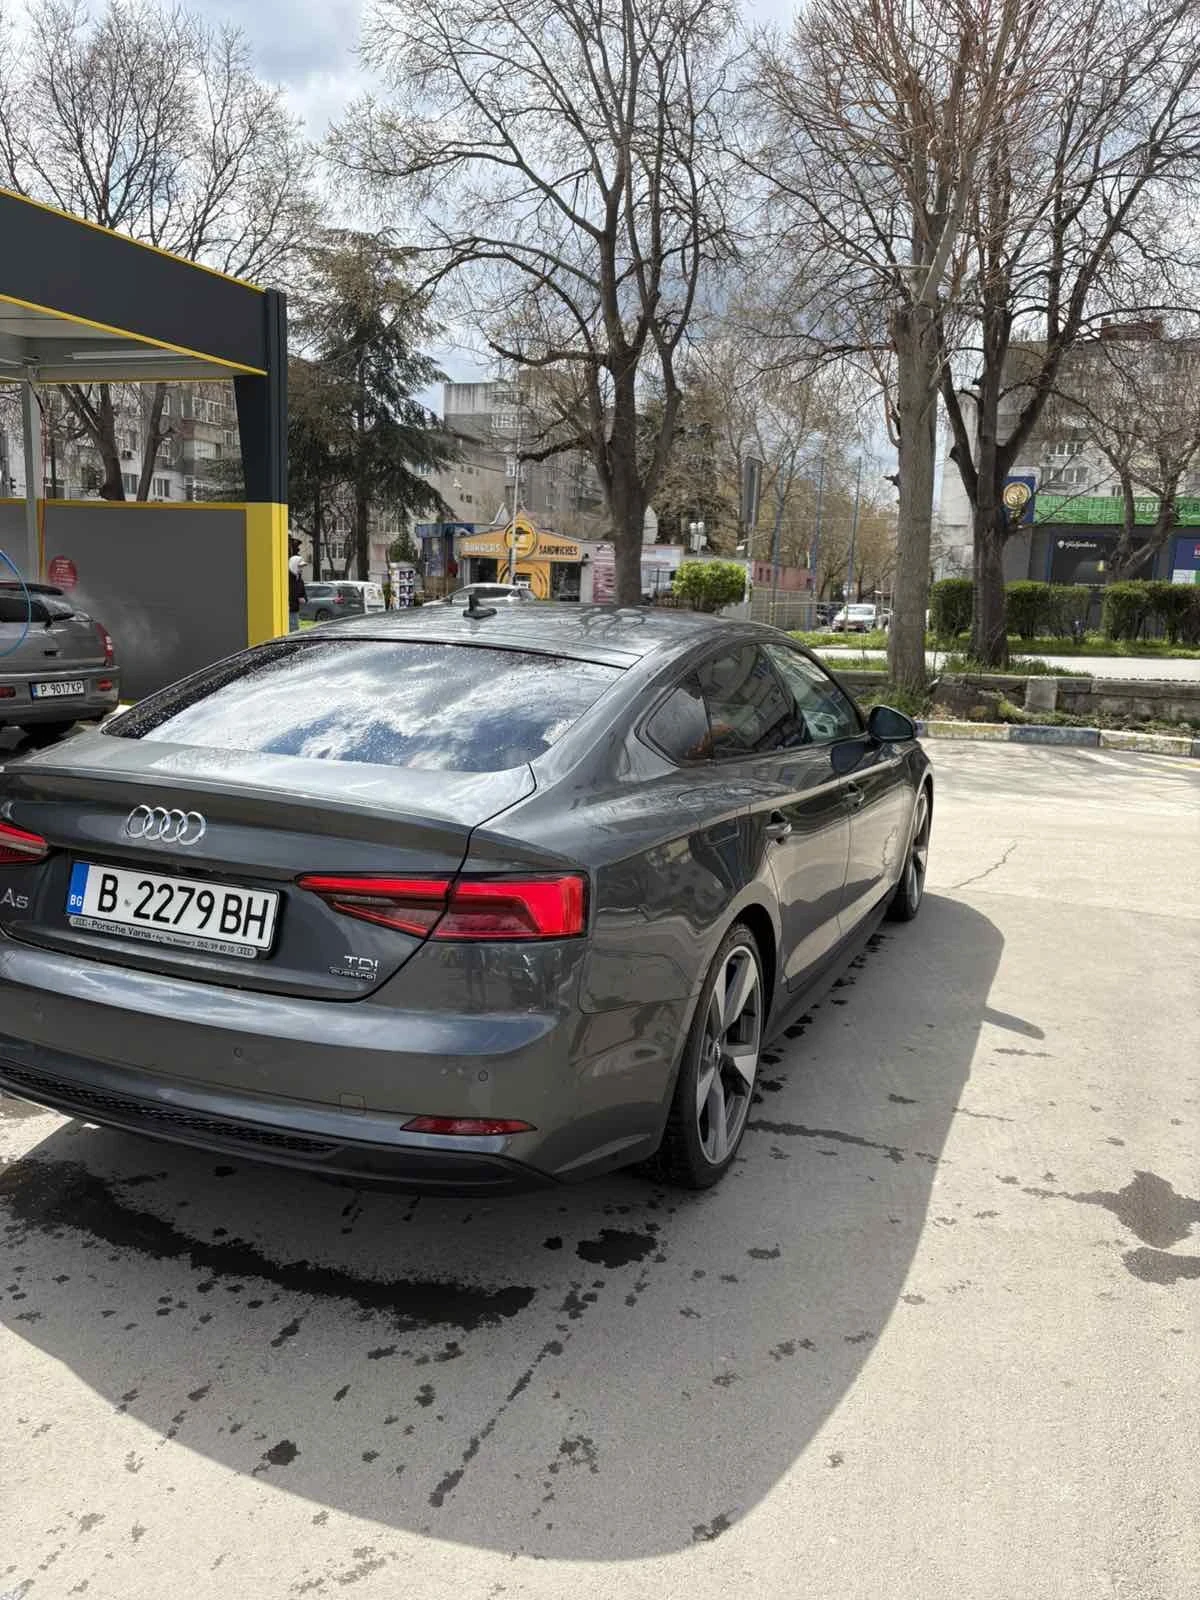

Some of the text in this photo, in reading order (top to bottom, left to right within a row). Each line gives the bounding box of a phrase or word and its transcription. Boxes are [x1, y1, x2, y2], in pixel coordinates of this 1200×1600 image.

[538, 543, 578, 555] SANDWICHES
[40, 684, 47, 694] P
[50, 682, 71, 696] 9017
[0, 887, 29, 909] A5
[69, 894, 83, 907] BG
[97, 873, 270, 940] B 2279 BH
[91, 919, 127, 936] Porsche
[127, 927, 152, 940] Varna
[343, 955, 379, 972] TDI
